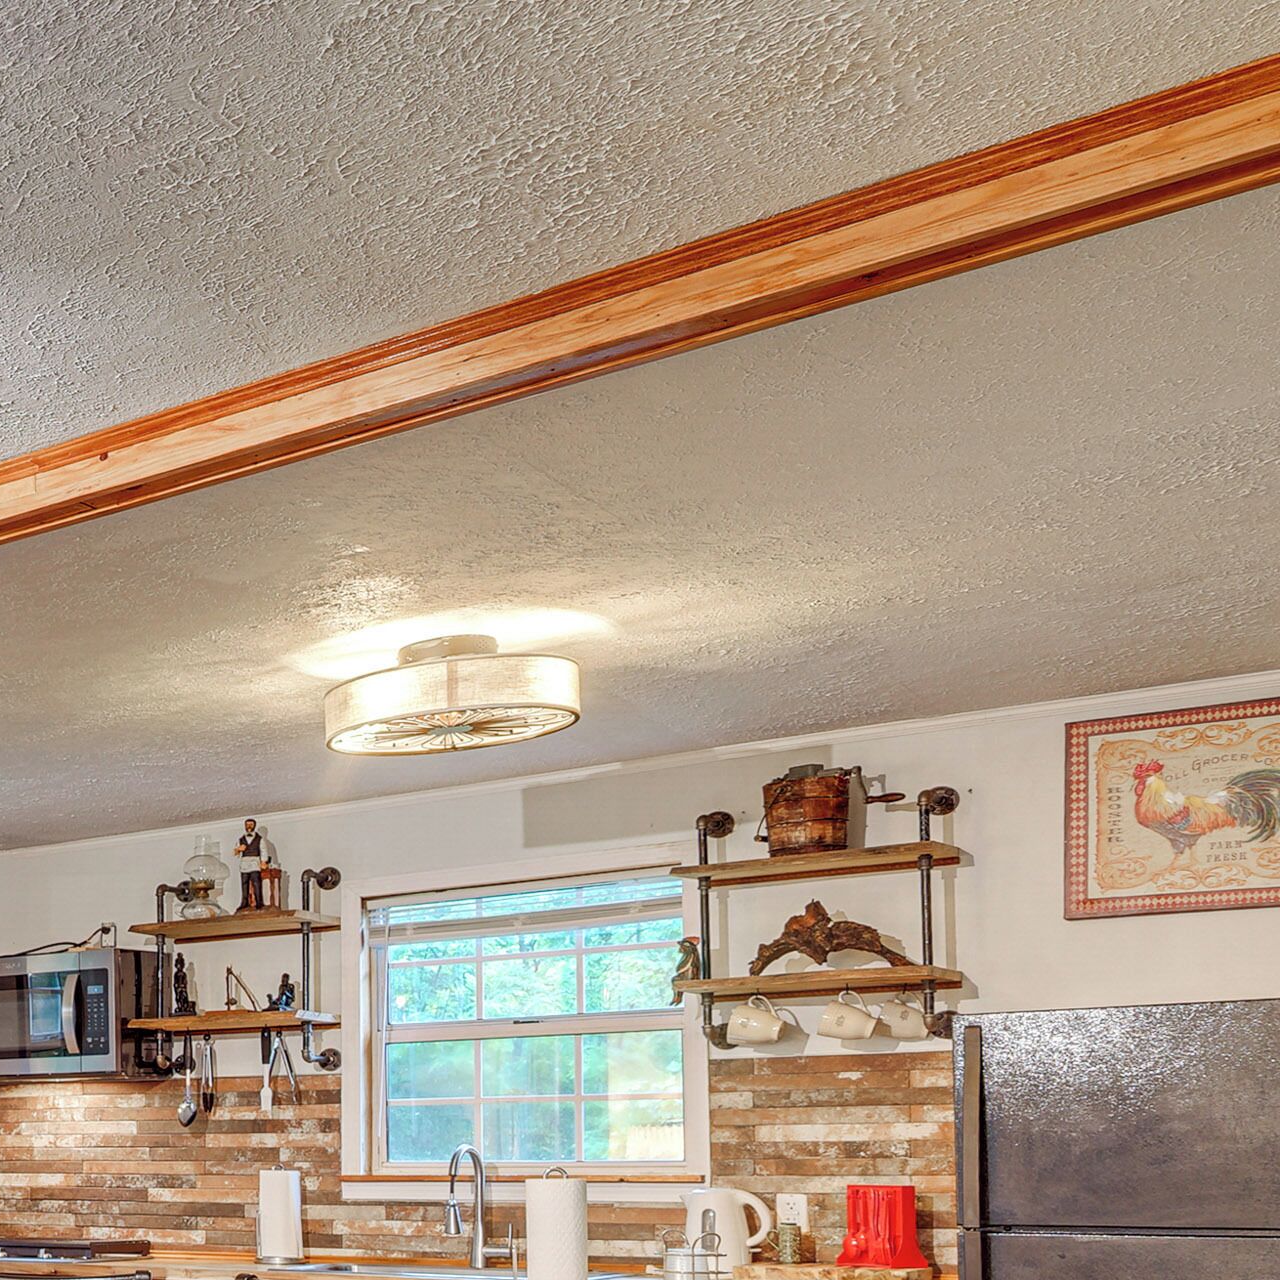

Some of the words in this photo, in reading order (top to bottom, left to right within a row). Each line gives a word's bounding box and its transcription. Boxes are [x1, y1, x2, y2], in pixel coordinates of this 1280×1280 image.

[1192, 753, 1249, 773] GROCER
[1208, 840, 1243, 850] FARM
[1206, 852, 1248, 863] FRESH
